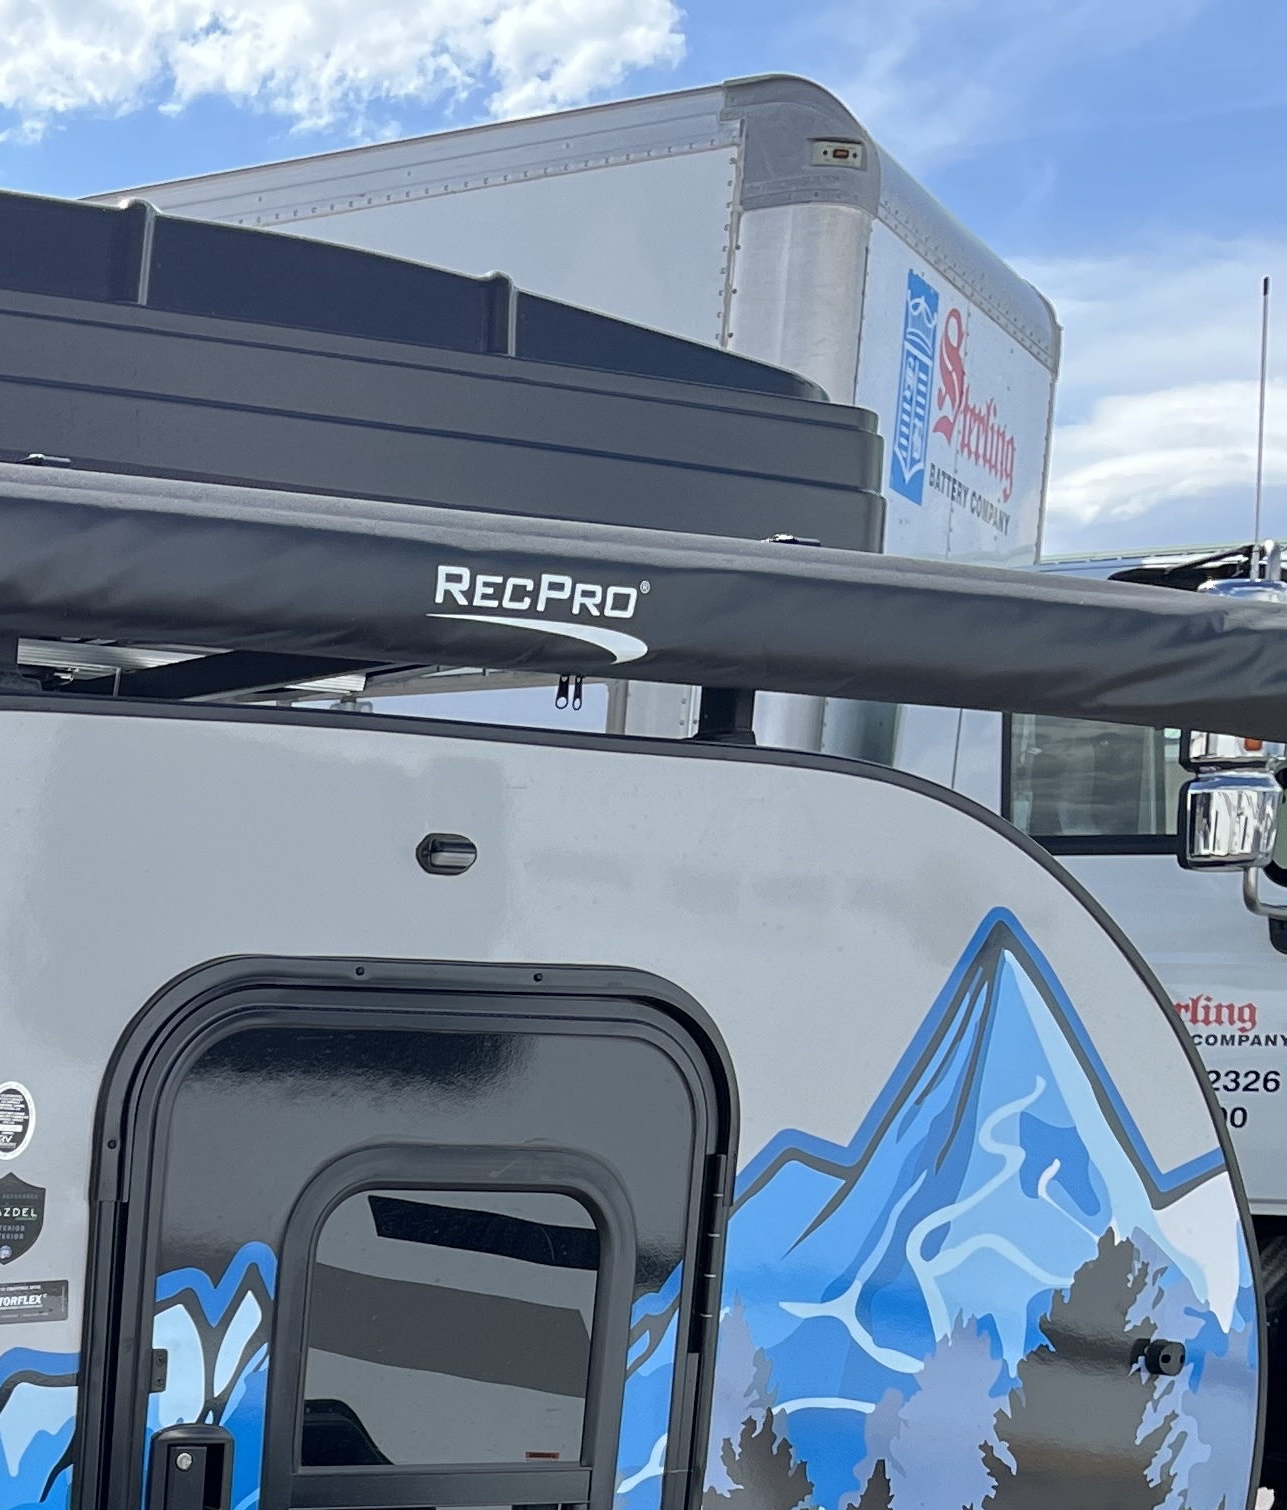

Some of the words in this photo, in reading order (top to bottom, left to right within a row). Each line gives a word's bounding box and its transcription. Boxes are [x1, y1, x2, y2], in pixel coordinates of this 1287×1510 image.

[933, 308, 1016, 503] Sterling
[930, 462, 969, 510] BATTERY
[969, 493, 1011, 535] COMPANY
[1173, 994, 1257, 1033] rling
[1221, 1106, 1247, 1129] 0
